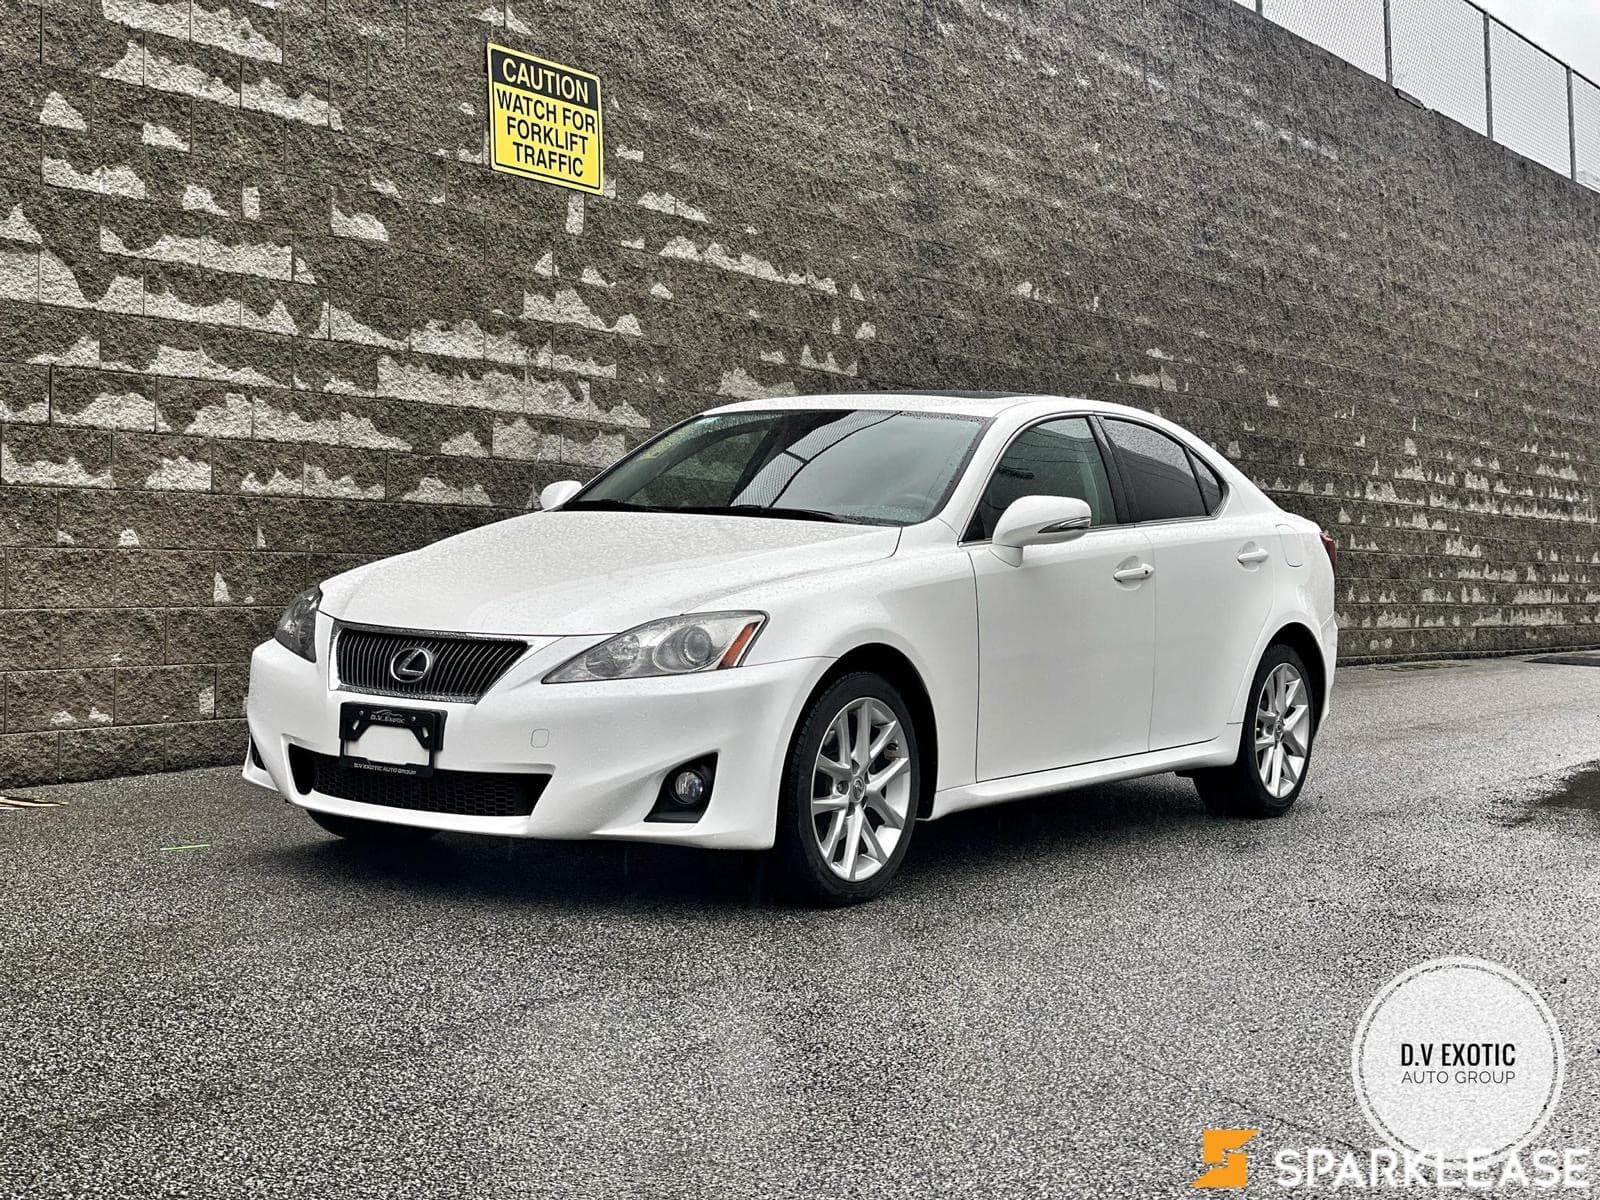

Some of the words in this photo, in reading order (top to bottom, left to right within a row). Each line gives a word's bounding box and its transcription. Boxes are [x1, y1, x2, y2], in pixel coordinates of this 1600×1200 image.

[502, 58, 589, 104] CAUTION
[496, 88, 557, 124] WATCH
[562, 107, 595, 134] FOR
[507, 116, 588, 155] FORKLIFT
[512, 141, 583, 177] TRAFFIC
[397, 767, 417, 775] GROUP
